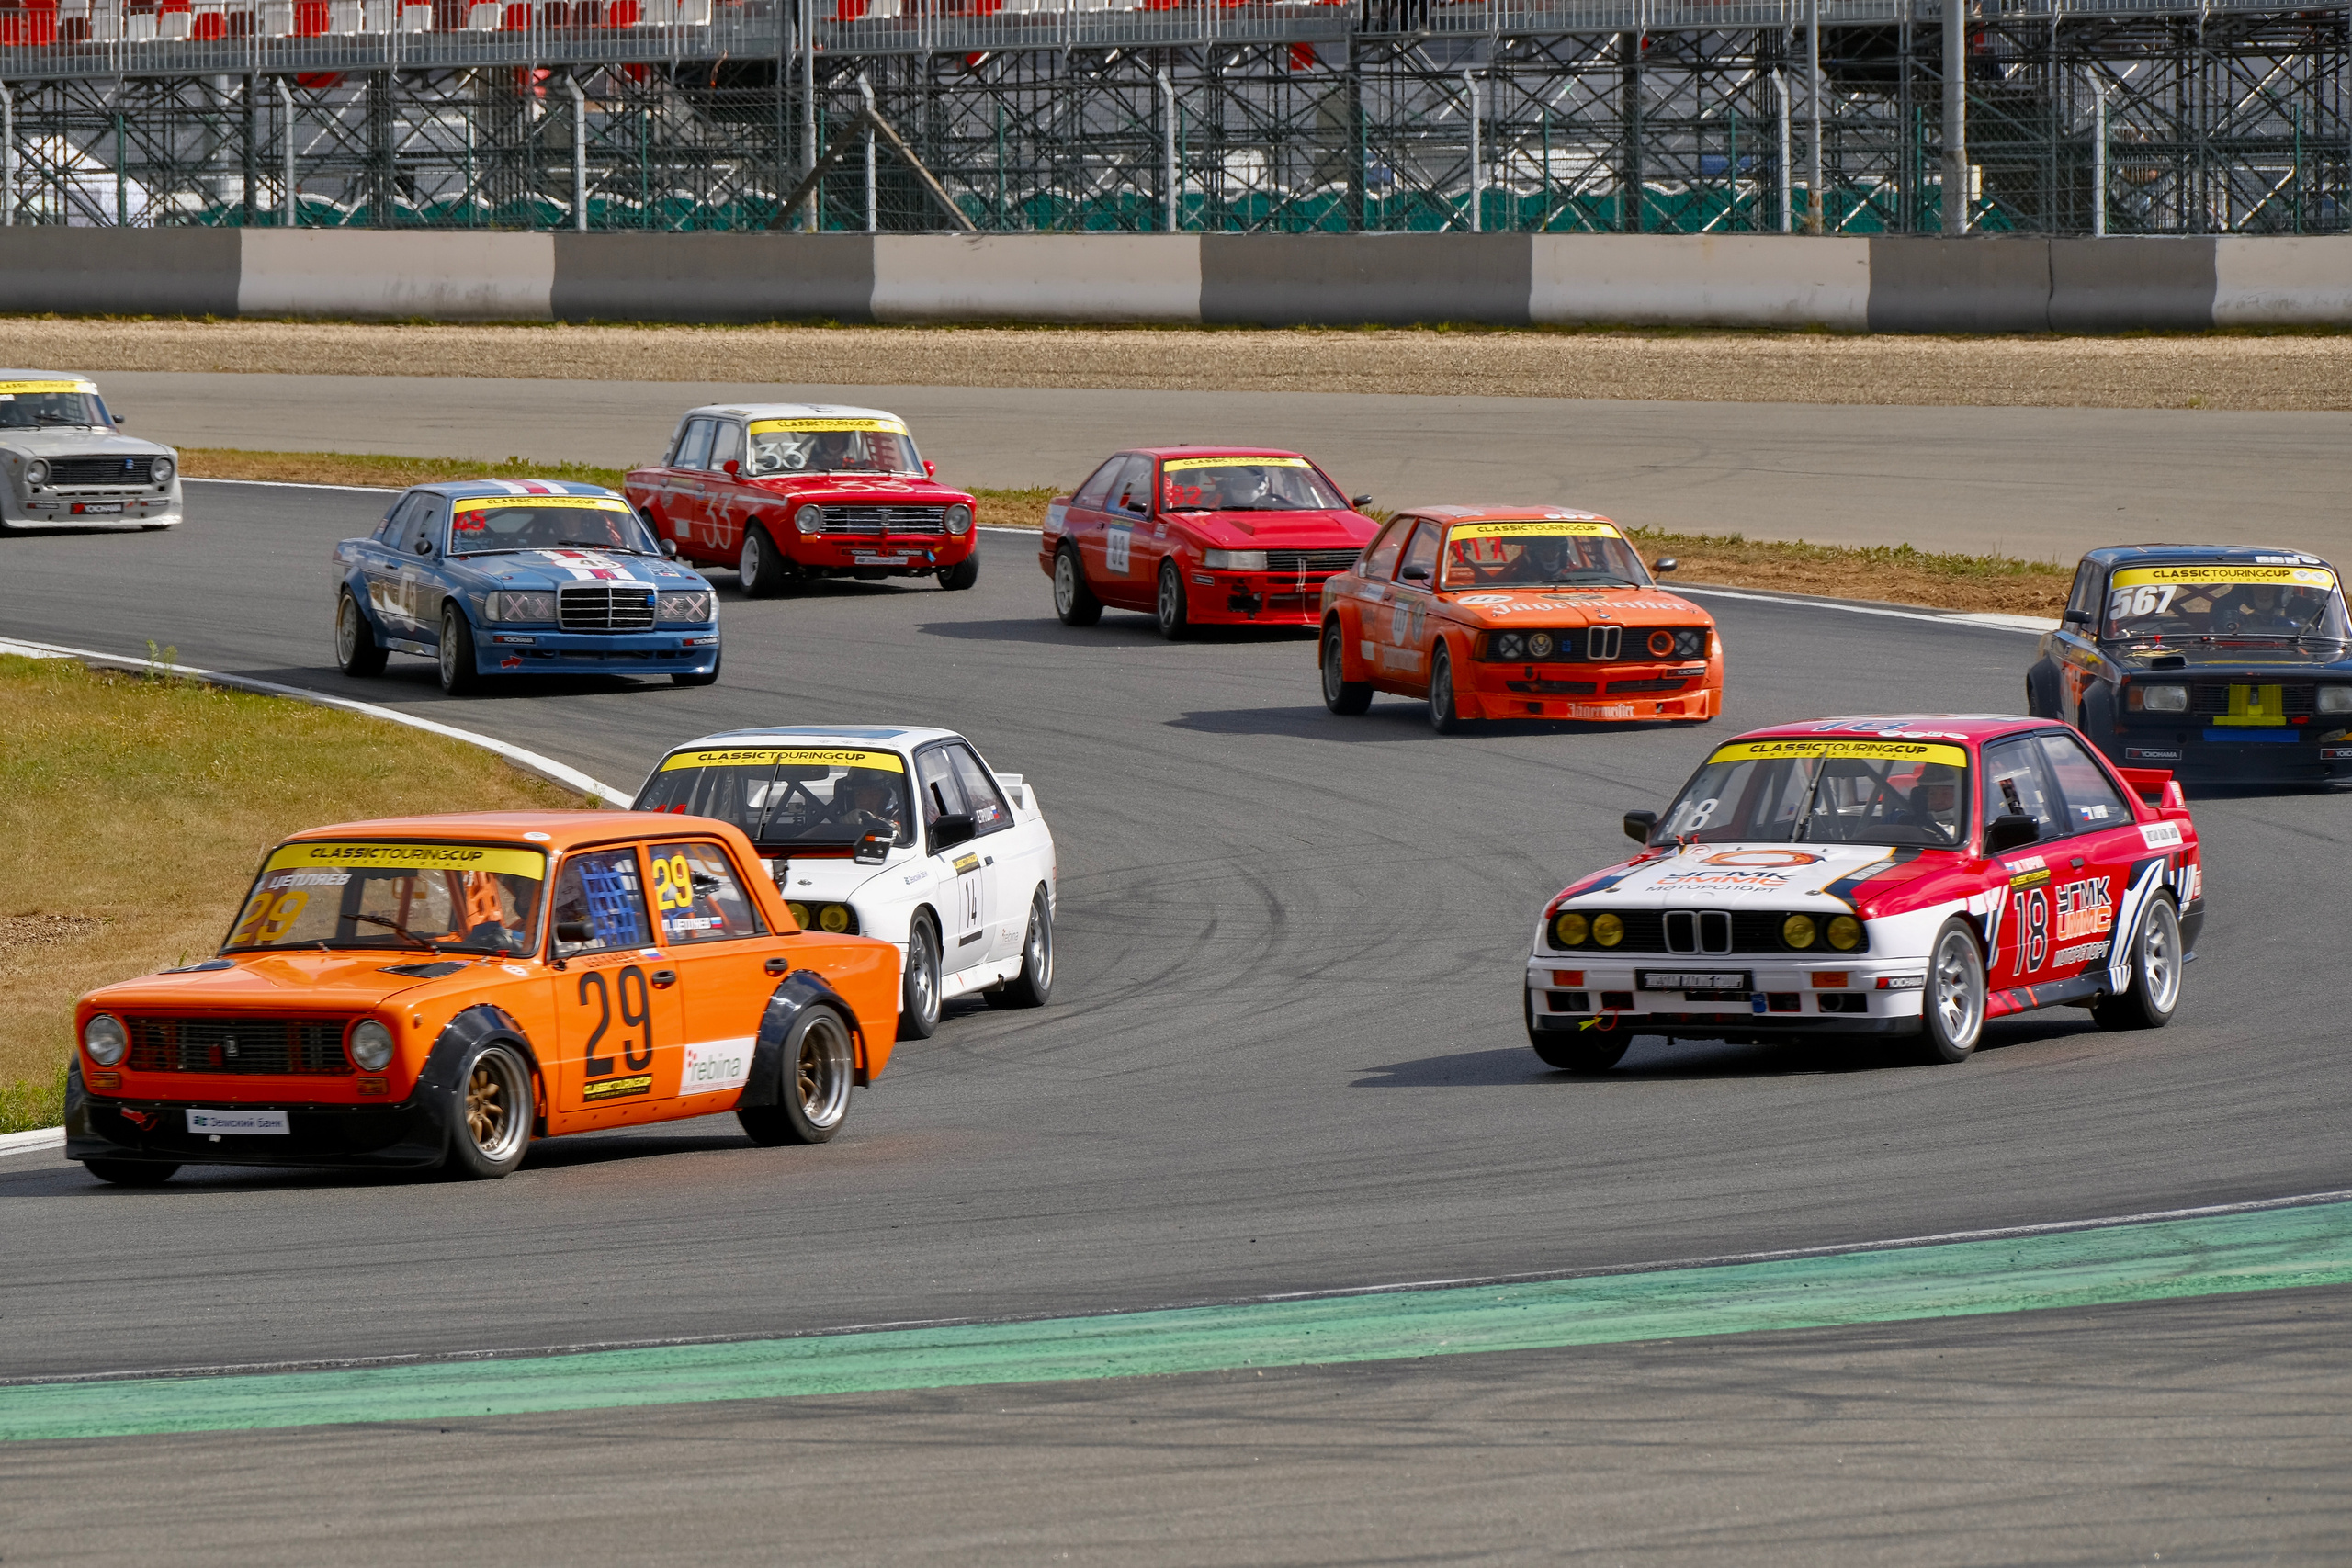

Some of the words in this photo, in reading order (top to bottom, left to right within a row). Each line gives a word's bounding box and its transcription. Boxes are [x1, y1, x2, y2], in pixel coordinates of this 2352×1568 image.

[758, 443, 807, 470] 33
[831, 481, 914, 492] 33
[1170, 486, 1202, 504] 82
[453, 510, 486, 530] 45
[702, 492, 733, 550] 33
[1477, 525, 1598, 533] CLASSICTOURINGCUP
[1450, 537, 1501, 563] 117
[2153, 569, 2290, 578] CLASSICTOURINGCUP
[1484, 600, 1687, 615] Jägermeister
[2109, 585, 2177, 620] 567
[1567, 703, 1634, 717] Jägermeister
[698, 751, 865, 761] CLASSICTOURINGCUP
[1749, 742, 1928, 753] CLASSICTOURINGCUP
[1667, 798, 1719, 834] 18
[310, 847, 484, 862] CLASSICTOURINGCUP
[652, 855, 694, 910] 29
[1645, 885, 1779, 893] МОТОРСПОРТ
[2055, 876, 2112, 914] УГМК
[965, 878, 977, 928] 14
[230, 891, 309, 942] 29
[2057, 905, 2112, 941] UMMC
[2012, 888, 2048, 976] 18
[578, 964, 653, 1077] 29
[690, 1052, 741, 1081] rebina
